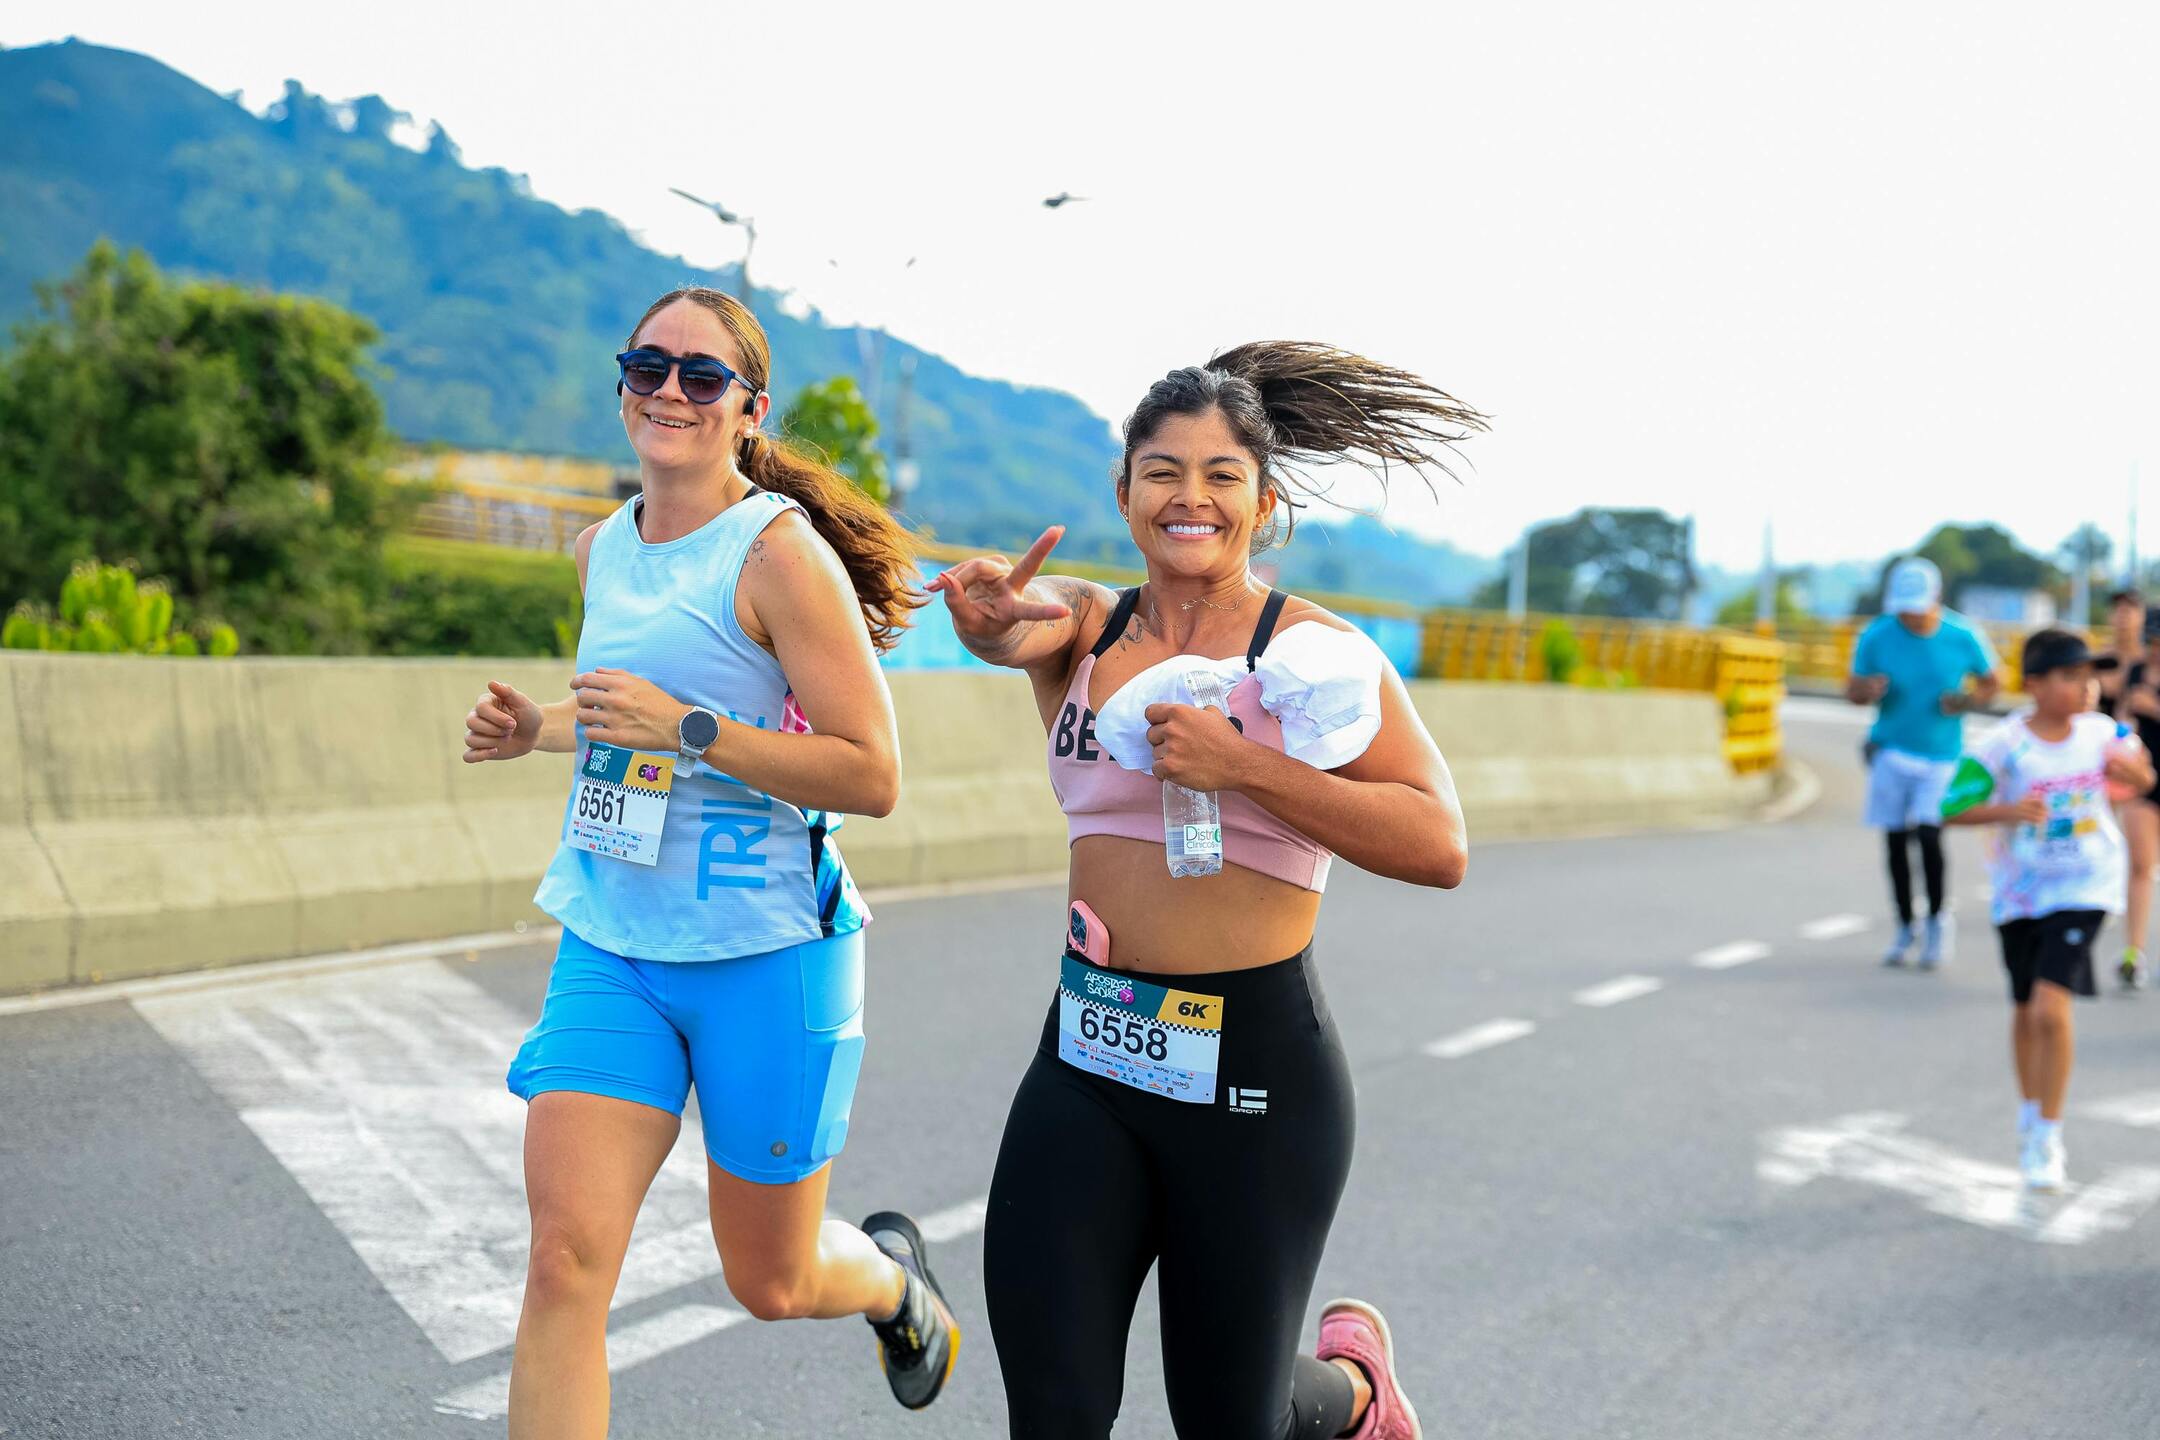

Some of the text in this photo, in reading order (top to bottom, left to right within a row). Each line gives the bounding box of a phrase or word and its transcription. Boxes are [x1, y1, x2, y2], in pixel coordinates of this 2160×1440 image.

[579, 785, 626, 825] 6561
[1178, 1001, 1209, 1019] 6K
[1080, 1007, 1168, 1061] 6558
[1229, 1107, 1267, 1115] IDROTT
